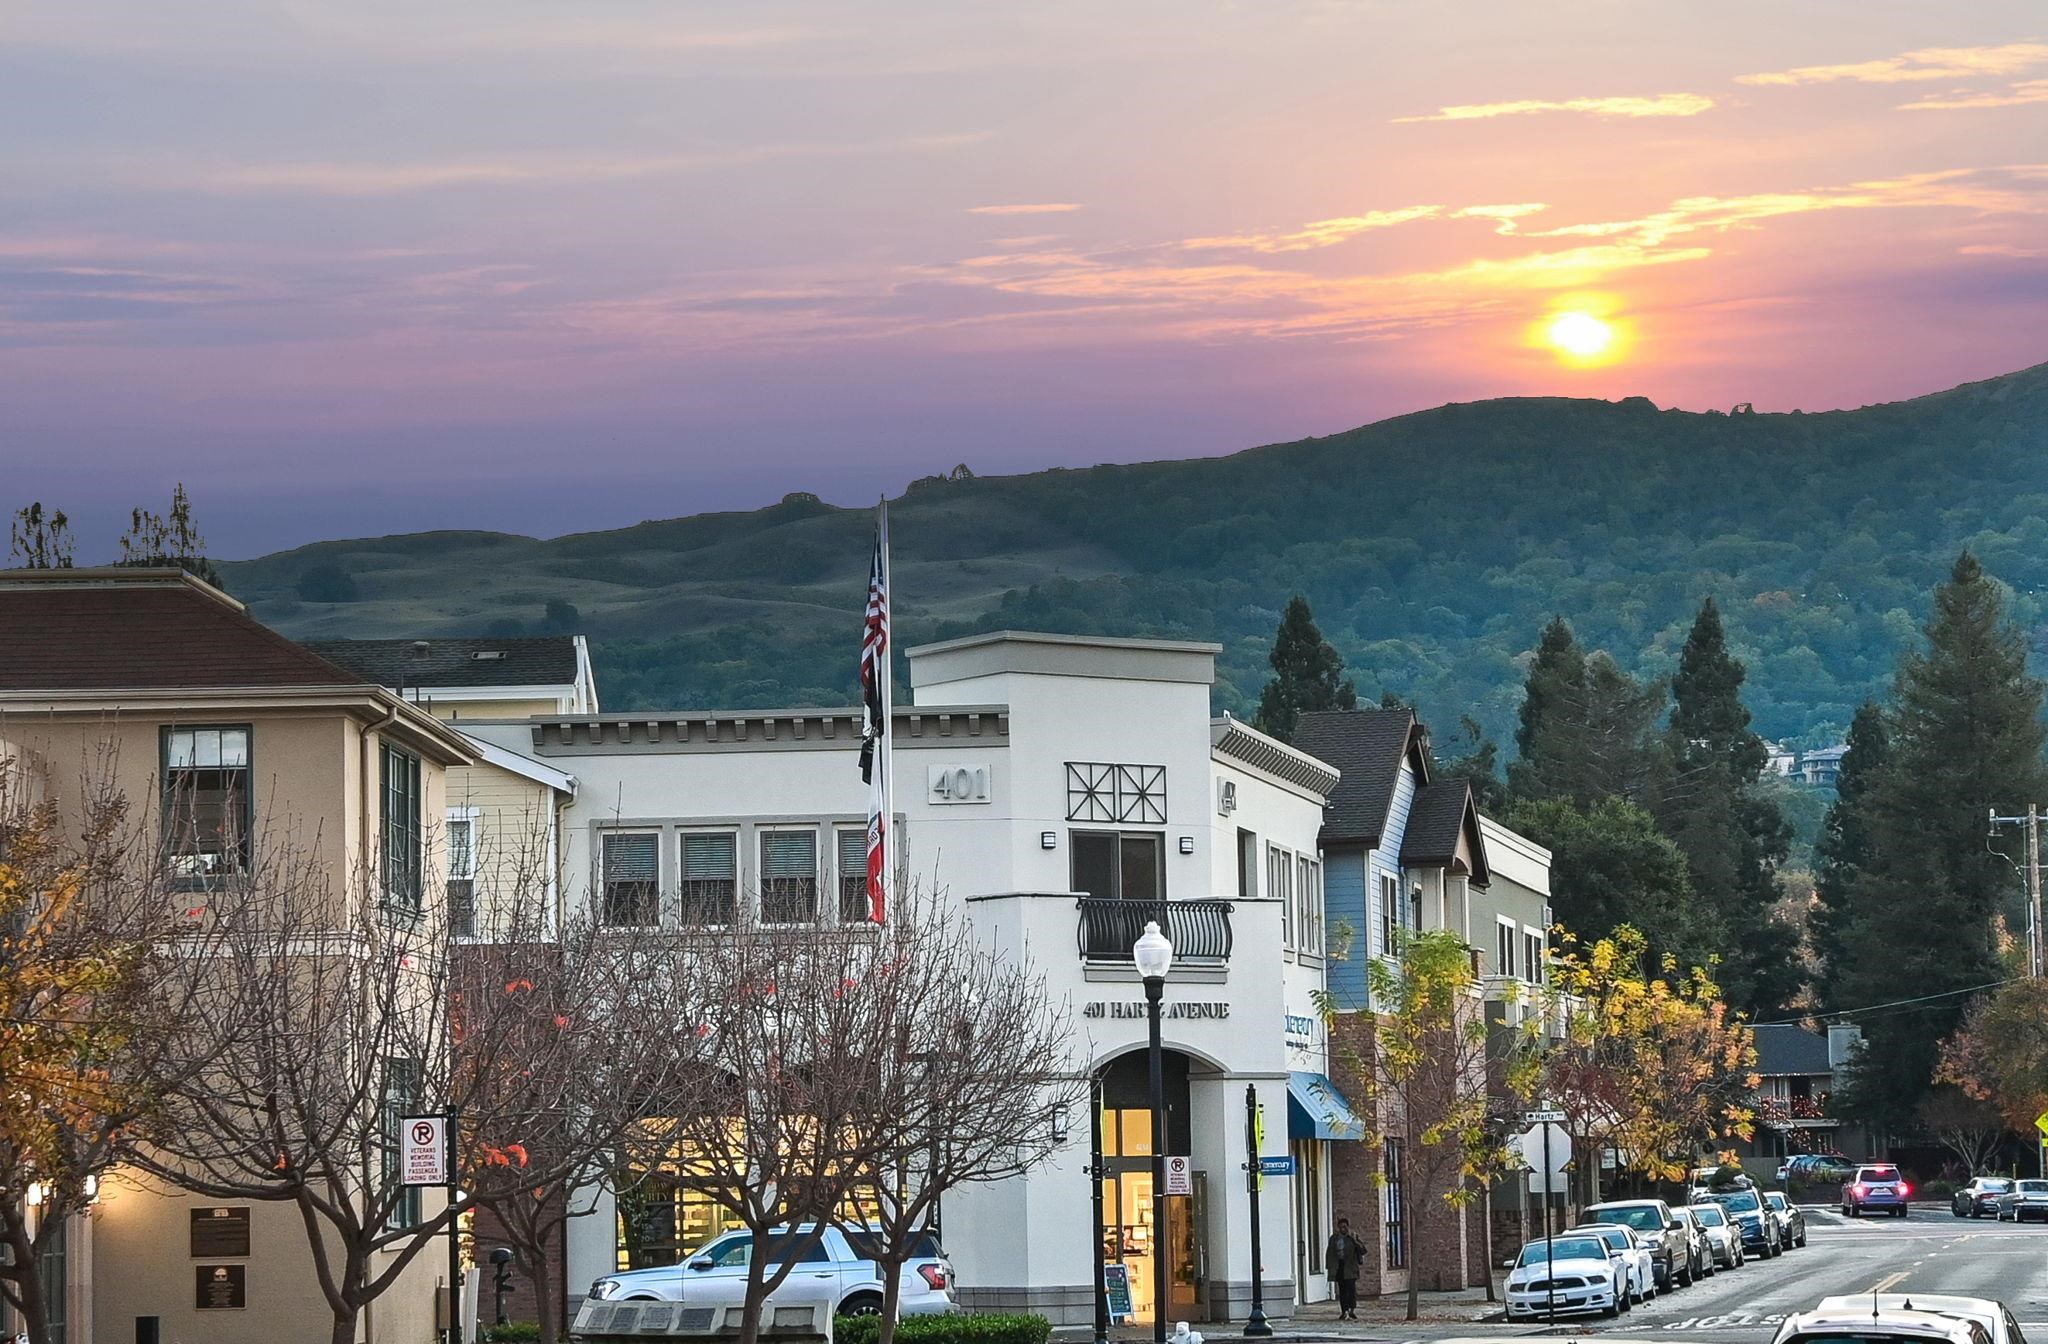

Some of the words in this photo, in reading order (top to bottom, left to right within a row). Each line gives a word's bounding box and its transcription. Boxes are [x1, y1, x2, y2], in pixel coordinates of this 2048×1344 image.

[933, 768, 986, 800] 401
[1083, 1002, 1105, 1019] 401
[1167, 1002, 1230, 1019] AVENUE
[1662, 1313, 1787, 1330] STOP
